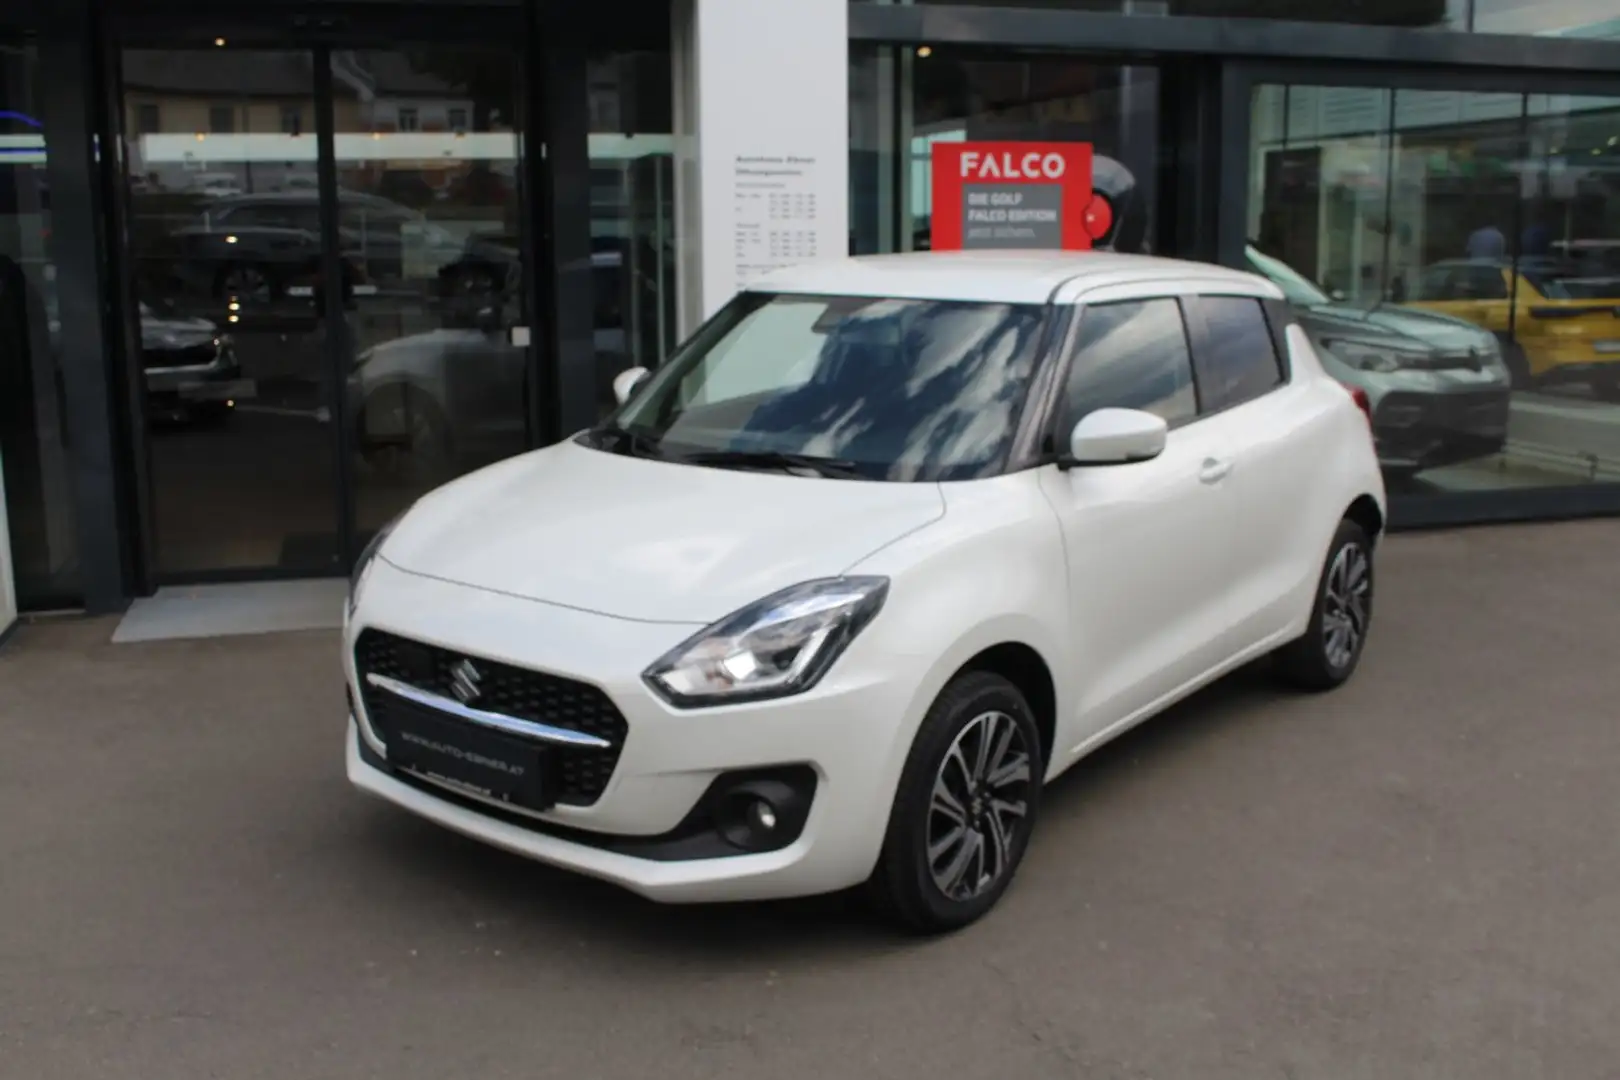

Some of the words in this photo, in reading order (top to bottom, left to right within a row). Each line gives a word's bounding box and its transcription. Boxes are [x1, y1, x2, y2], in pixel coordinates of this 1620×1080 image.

[960, 152, 1065, 178] FALCO
[991, 192, 1022, 205] GOLF
[968, 209, 1007, 221] FALCO
[1008, 209, 1057, 221] EDITION
